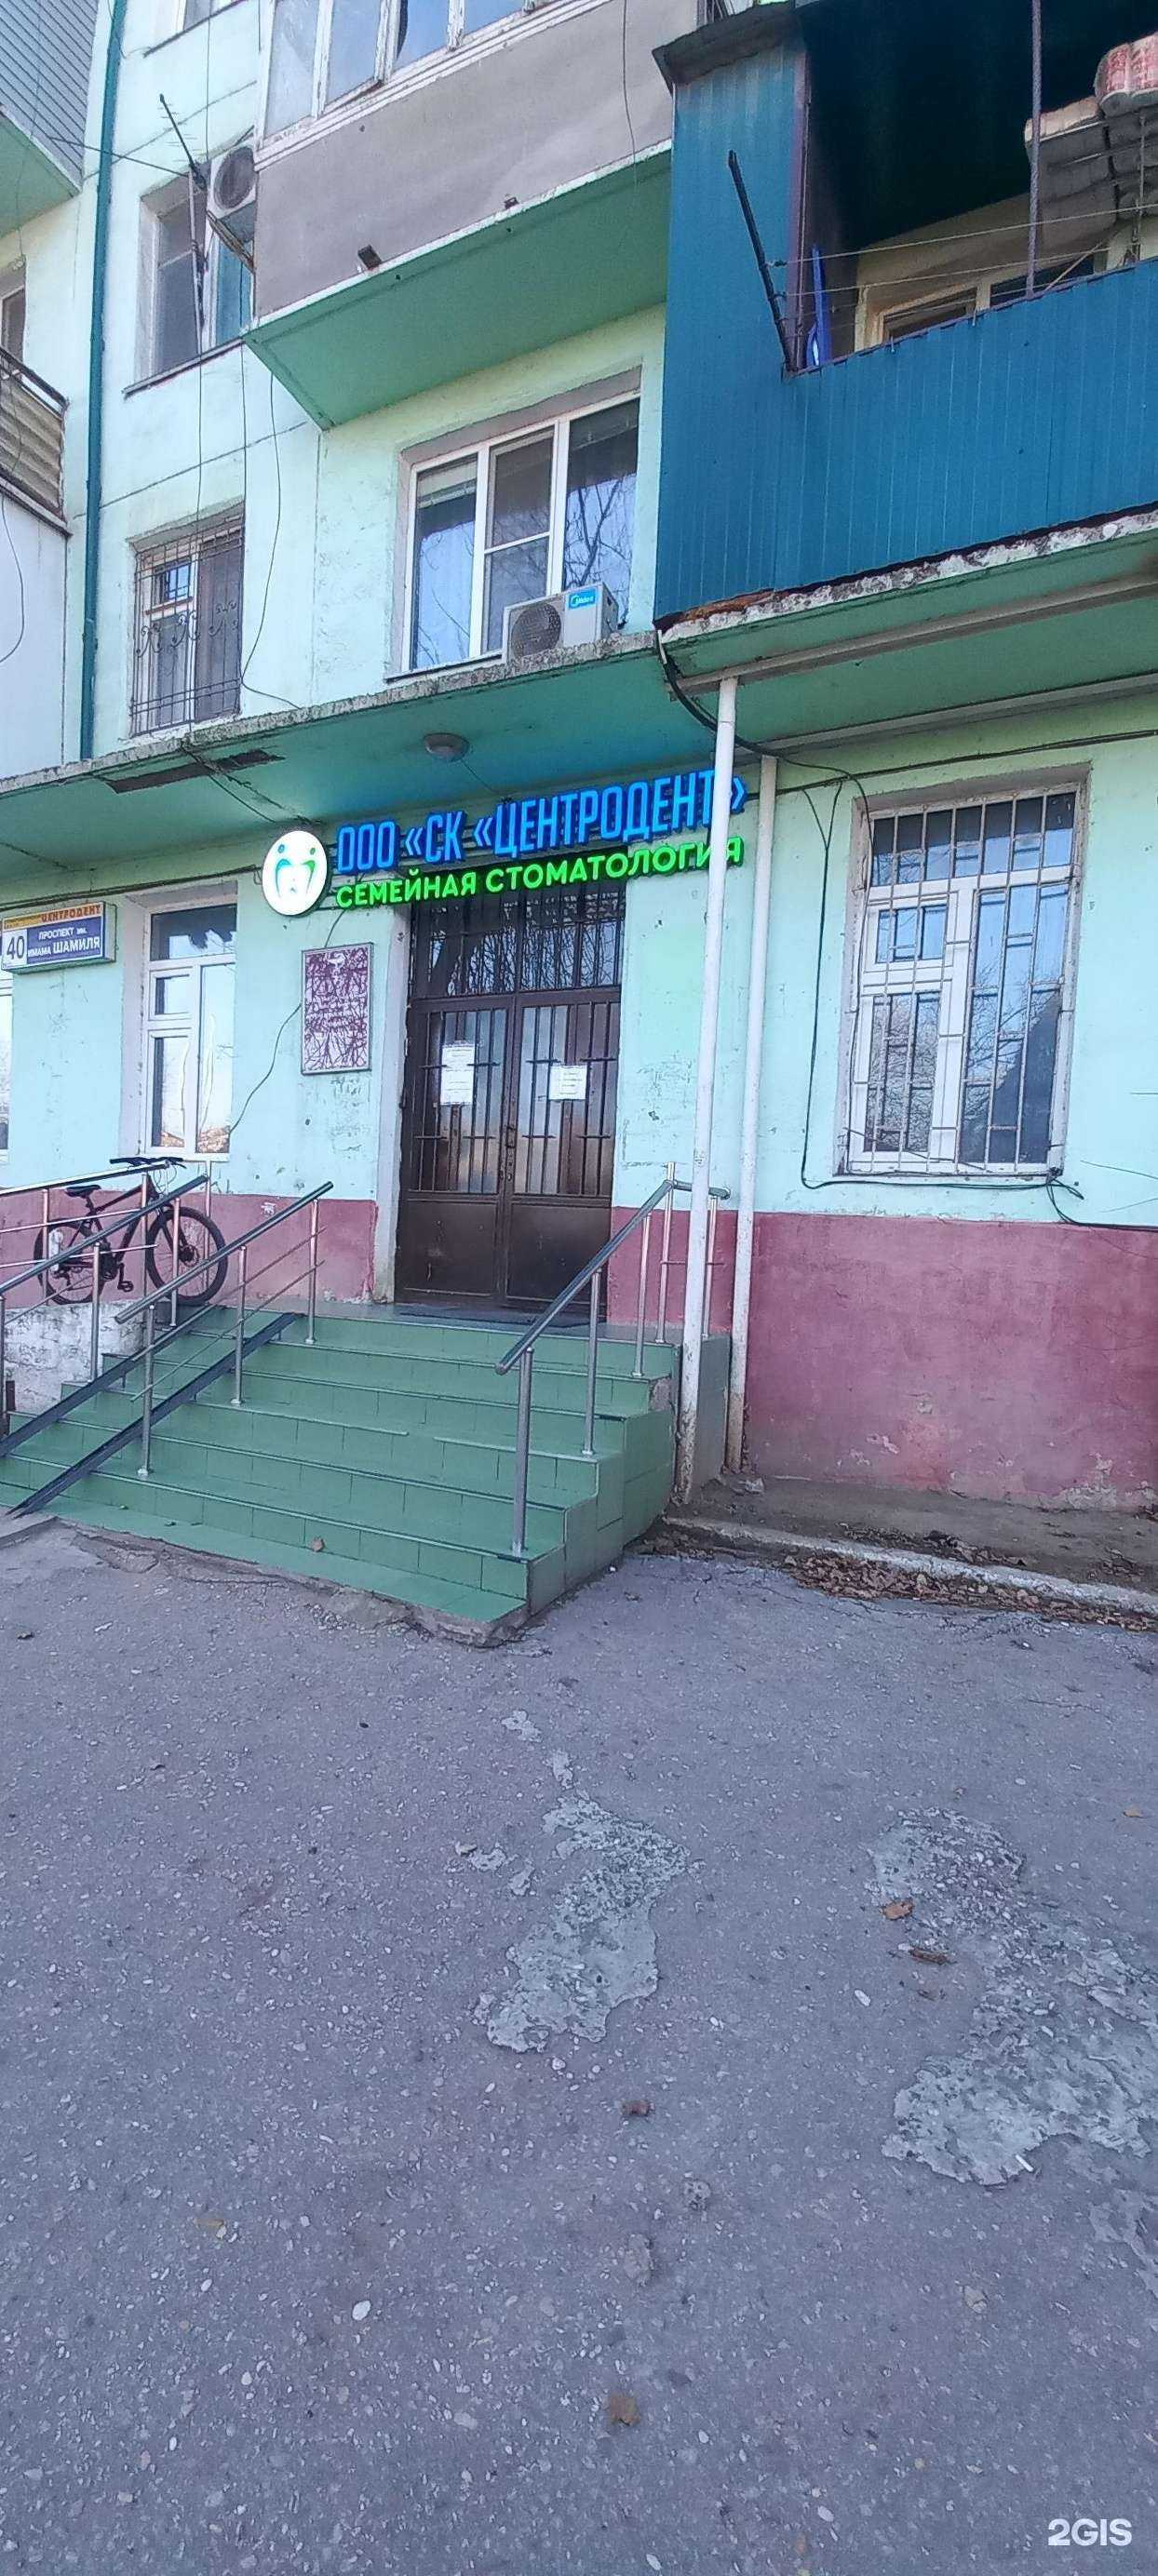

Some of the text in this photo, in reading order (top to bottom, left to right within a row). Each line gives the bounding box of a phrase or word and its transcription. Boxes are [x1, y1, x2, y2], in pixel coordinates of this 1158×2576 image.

[337, 820, 397, 873] ООО
[404, 811, 465, 864] «СК
[335, 836, 745, 909] СЕМЕЙНАЯ СТОМАТОЛОГИЯ
[41, 905, 102, 923] ЦЕНТРОДЕНТ
[38, 927, 74, 940] ПРОСПЕКТ
[7, 935, 25, 959] 40
[53, 936, 101, 954] ШАМИЛЯ
